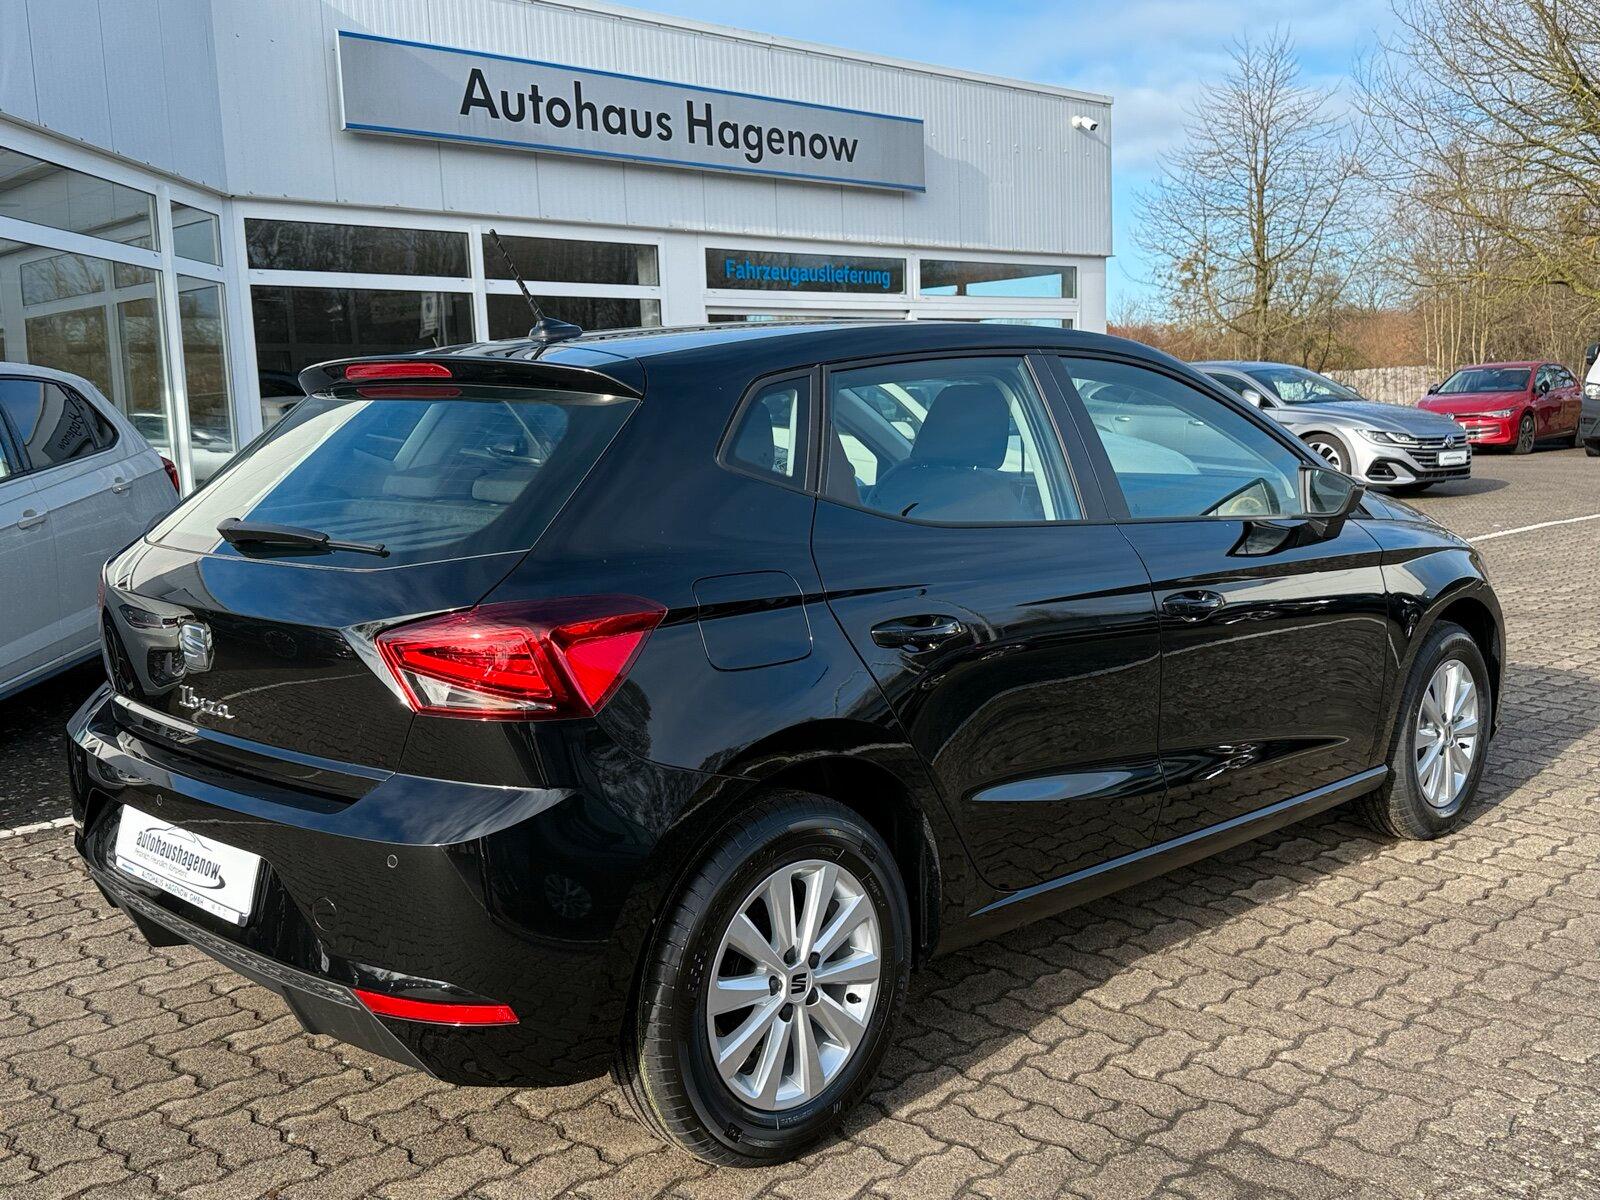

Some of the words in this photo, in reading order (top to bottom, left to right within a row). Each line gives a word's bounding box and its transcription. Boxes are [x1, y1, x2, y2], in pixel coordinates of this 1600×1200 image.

[460, 68, 673, 142] Autohaus
[686, 100, 859, 164] Hagenow
[725, 256, 891, 289] Fahrzeugauslieferung
[179, 684, 236, 719] Ibiza
[136, 831, 222, 880] autohaushagenow
